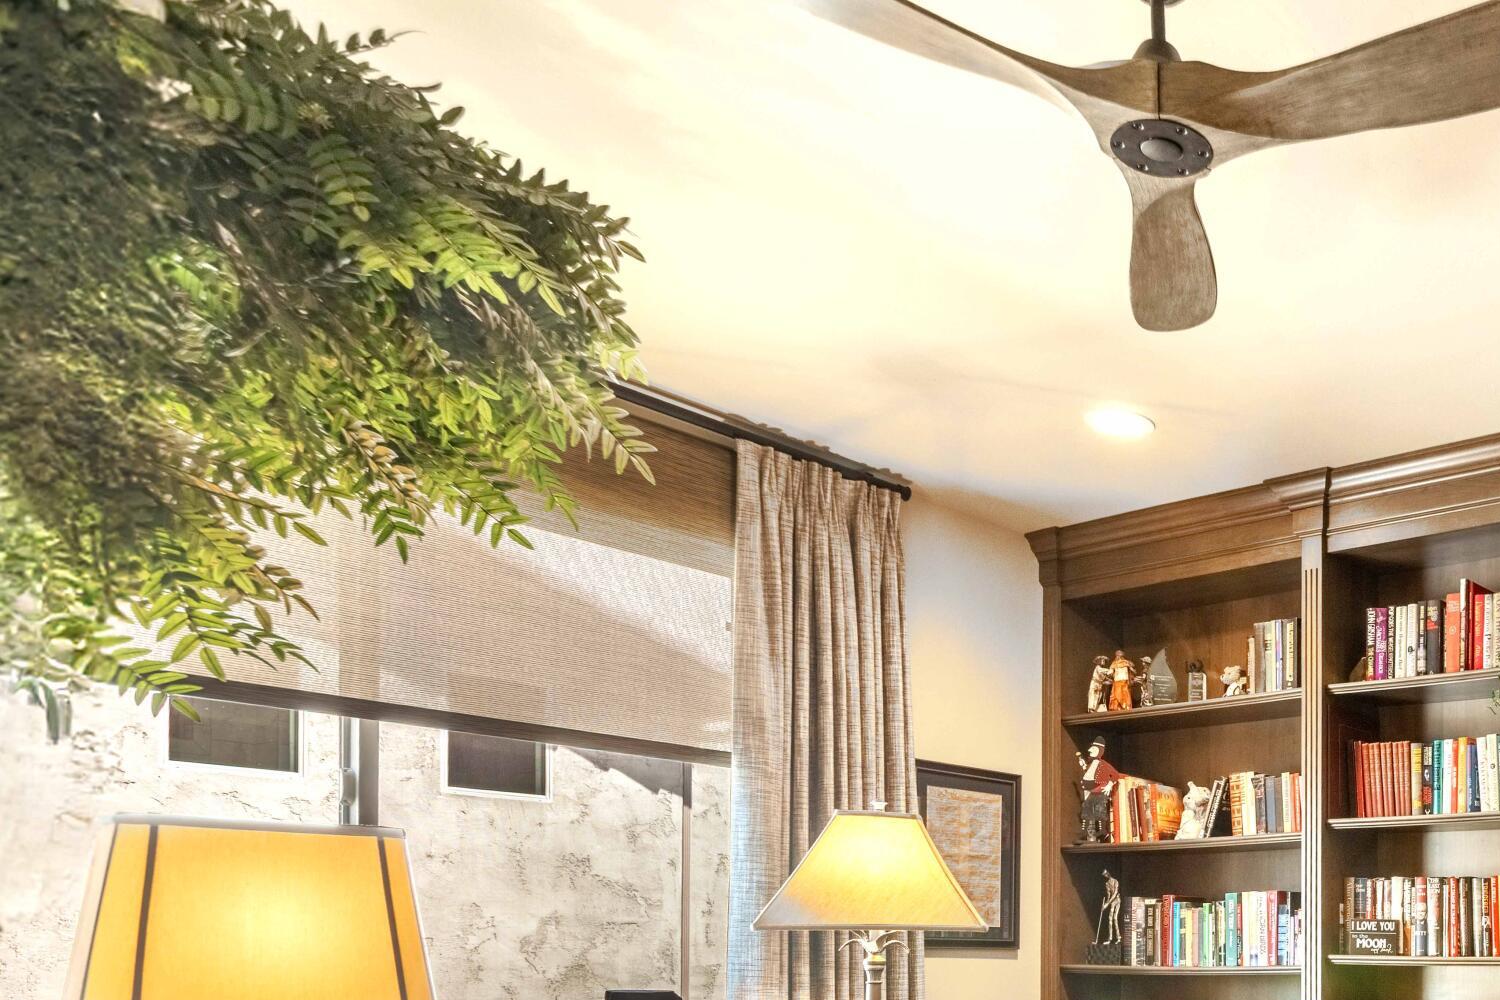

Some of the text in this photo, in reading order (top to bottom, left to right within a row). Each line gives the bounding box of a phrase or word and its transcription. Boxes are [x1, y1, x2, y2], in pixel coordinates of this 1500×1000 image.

[1351, 921, 1395, 932] I LOVE YOU
[1356, 938, 1387, 949] MOON
